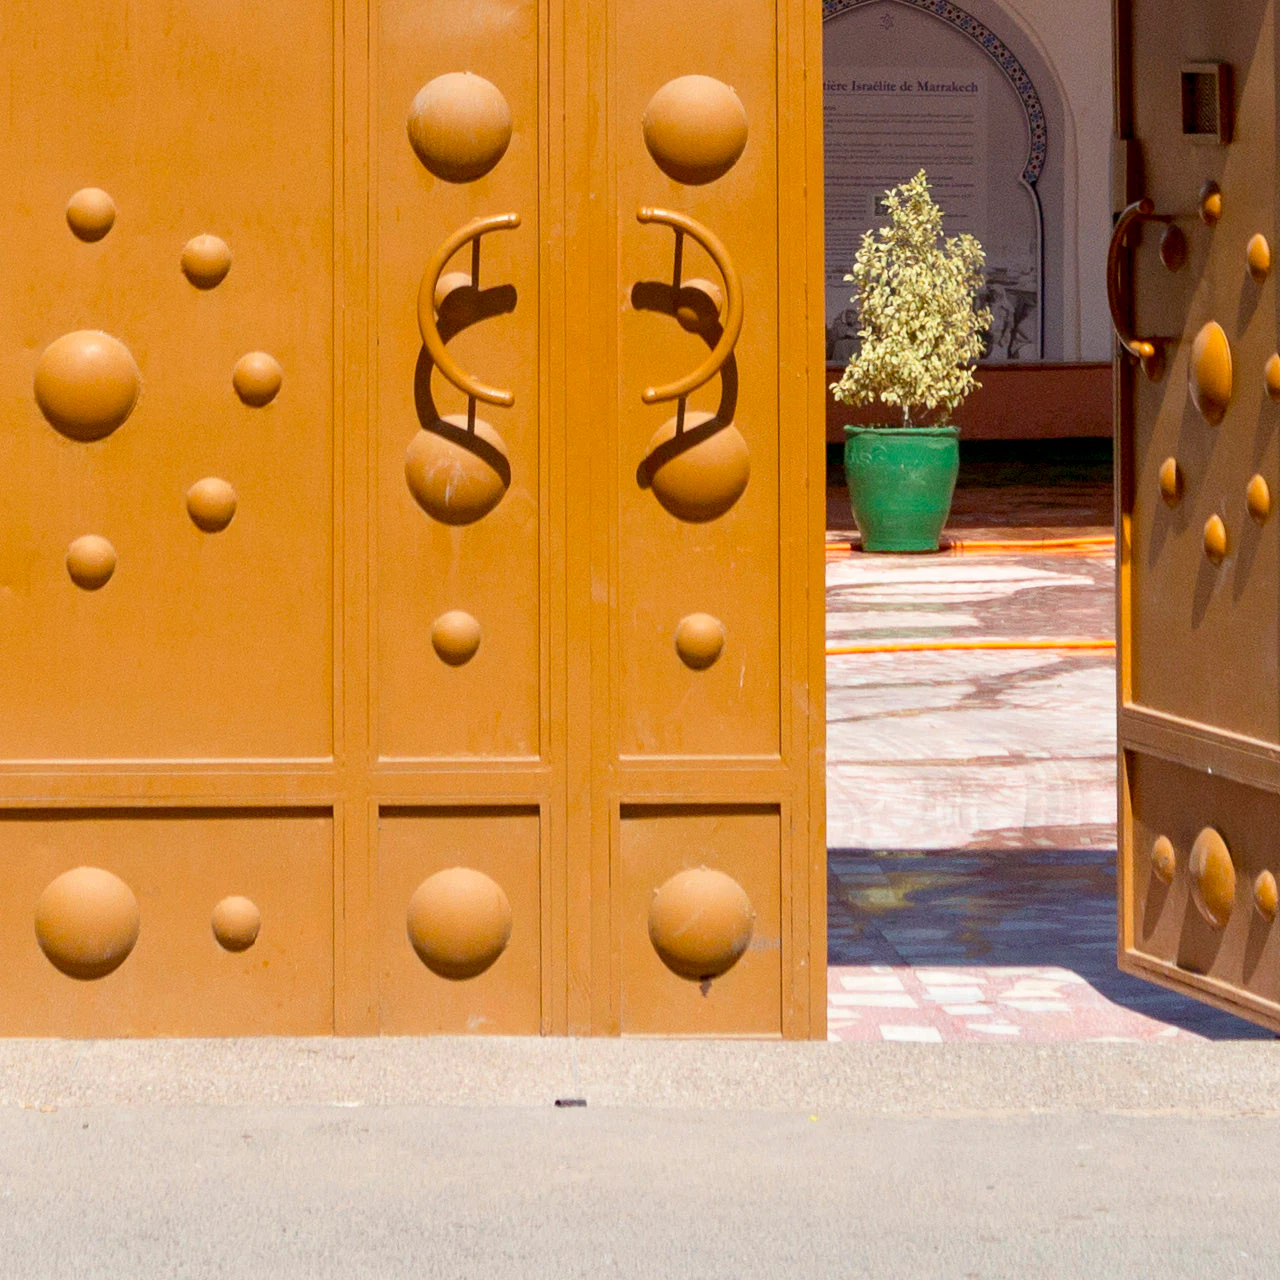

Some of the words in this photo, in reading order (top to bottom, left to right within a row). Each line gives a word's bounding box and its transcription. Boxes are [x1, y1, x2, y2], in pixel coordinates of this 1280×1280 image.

[852, 80, 897, 91] Israélite
[900, 80, 913, 92] de
[917, 80, 979, 93] Marrakech
